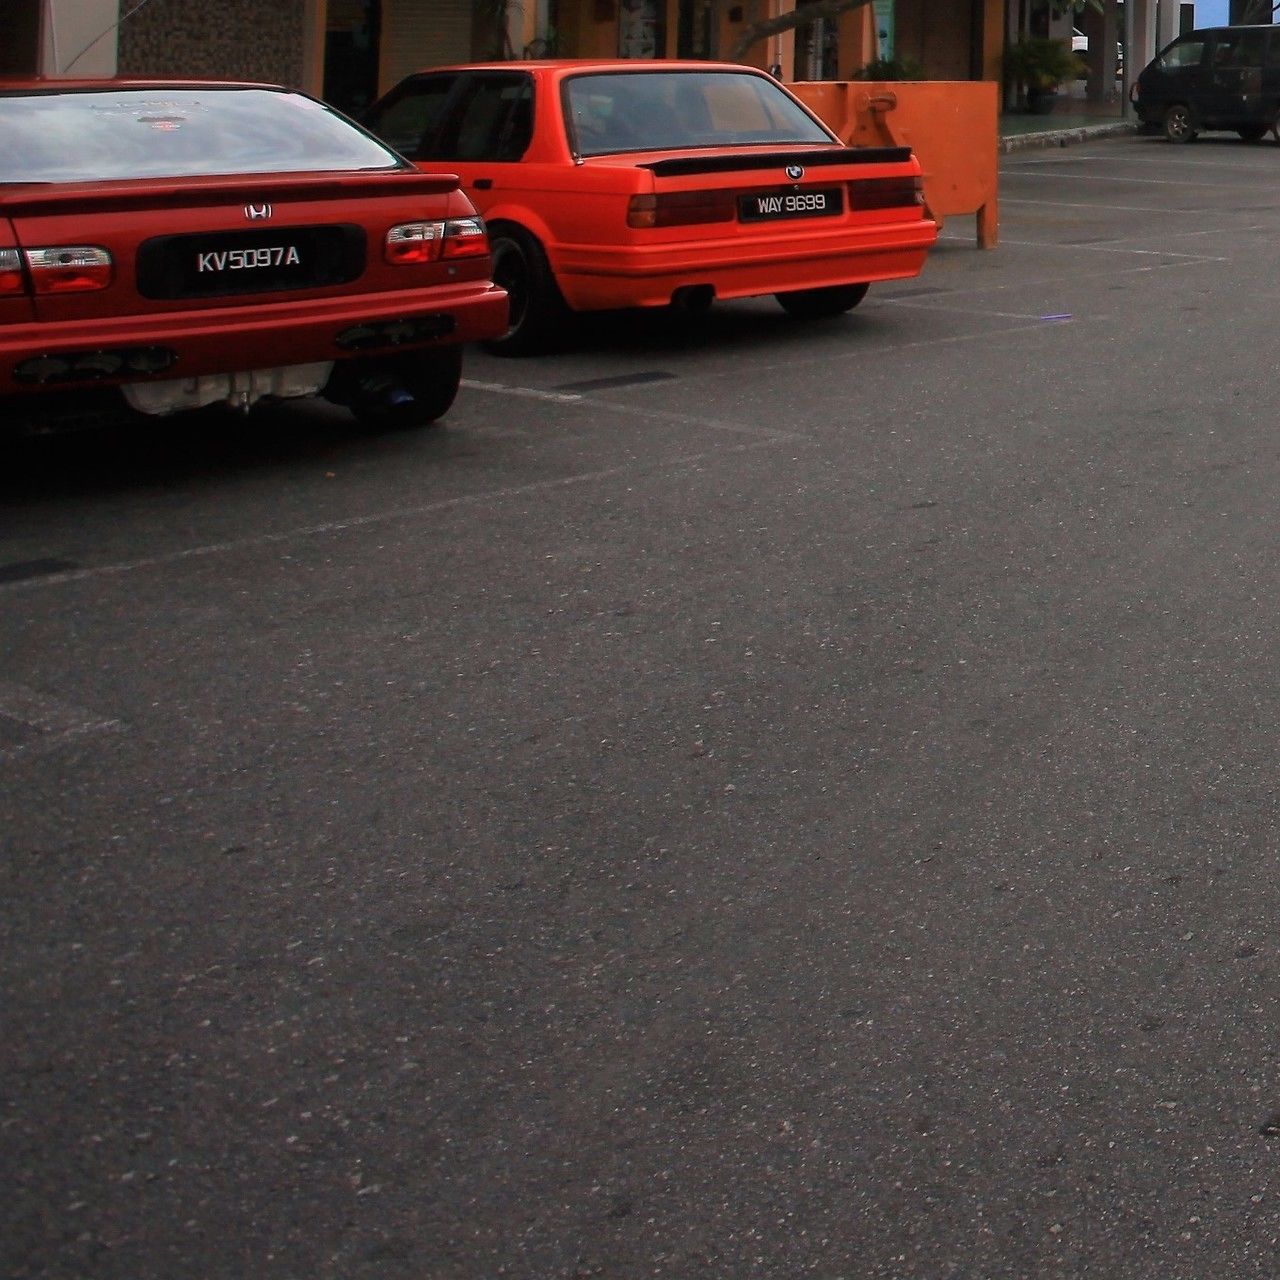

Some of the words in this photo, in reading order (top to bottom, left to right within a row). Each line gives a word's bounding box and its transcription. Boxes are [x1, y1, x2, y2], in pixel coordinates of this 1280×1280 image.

[758, 196, 784, 213] WAY
[785, 194, 826, 212] 9699
[198, 246, 300, 272] KV5097A
